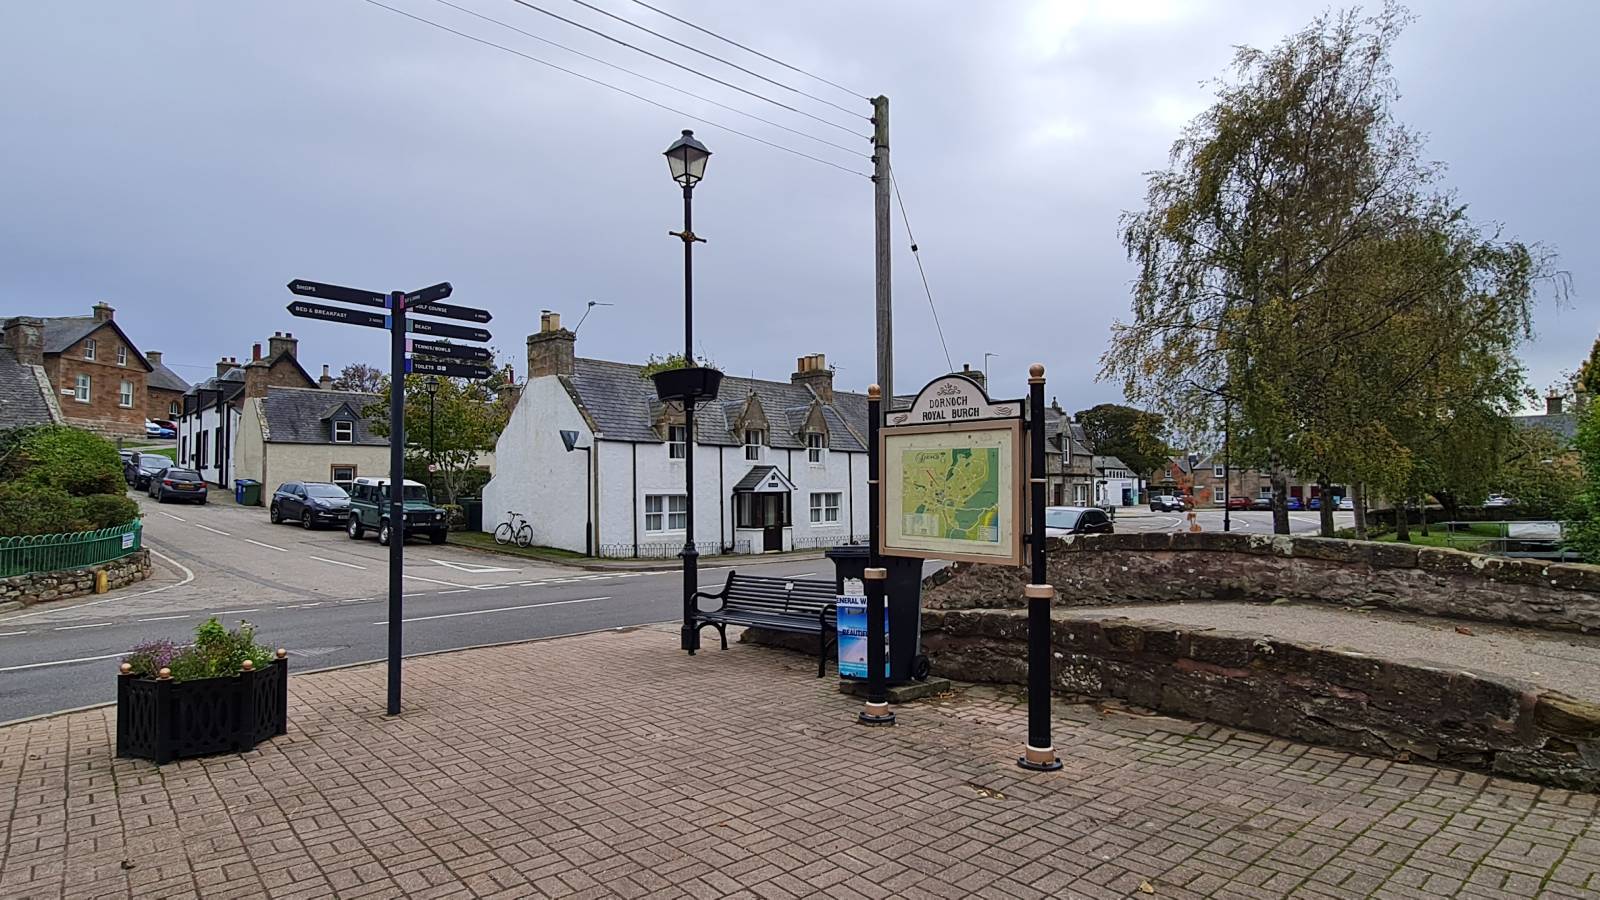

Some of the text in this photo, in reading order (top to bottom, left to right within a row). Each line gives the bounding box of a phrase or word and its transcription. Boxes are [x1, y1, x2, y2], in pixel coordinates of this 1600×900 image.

[296, 284, 316, 292] SHOPS
[314, 308, 347, 318] BREAKFAST
[415, 344, 451, 352] TENNIS/BOWLS
[929, 395, 968, 409] DORNOCH
[922, 410, 946, 421] ROYAL
